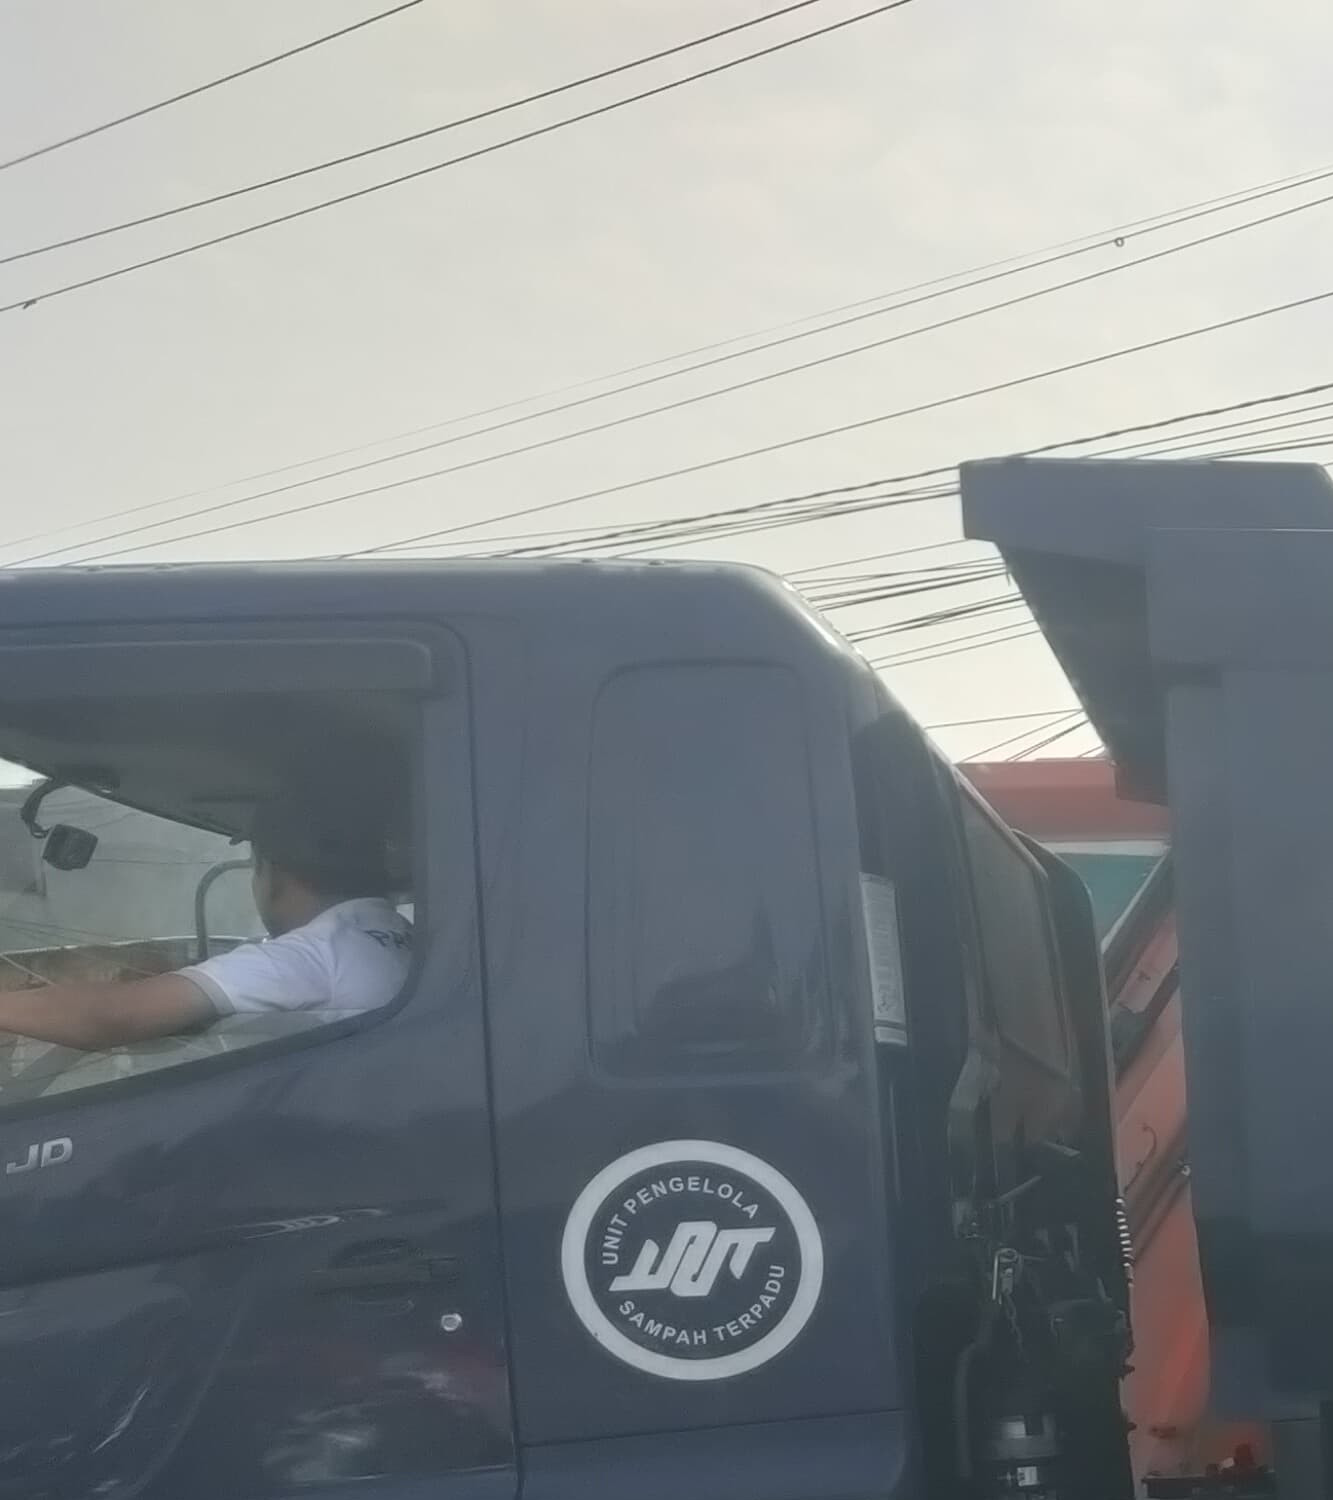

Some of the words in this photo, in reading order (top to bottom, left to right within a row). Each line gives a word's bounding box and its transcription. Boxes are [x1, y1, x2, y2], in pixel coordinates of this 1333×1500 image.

[6, 1137, 73, 1175] JD
[602, 1213, 628, 1265] UNIT
[623, 1176, 759, 1219] PENGELOLA
[619, 1300, 707, 1345] SAMPAH
[713, 1264, 785, 1342] TERPADU
